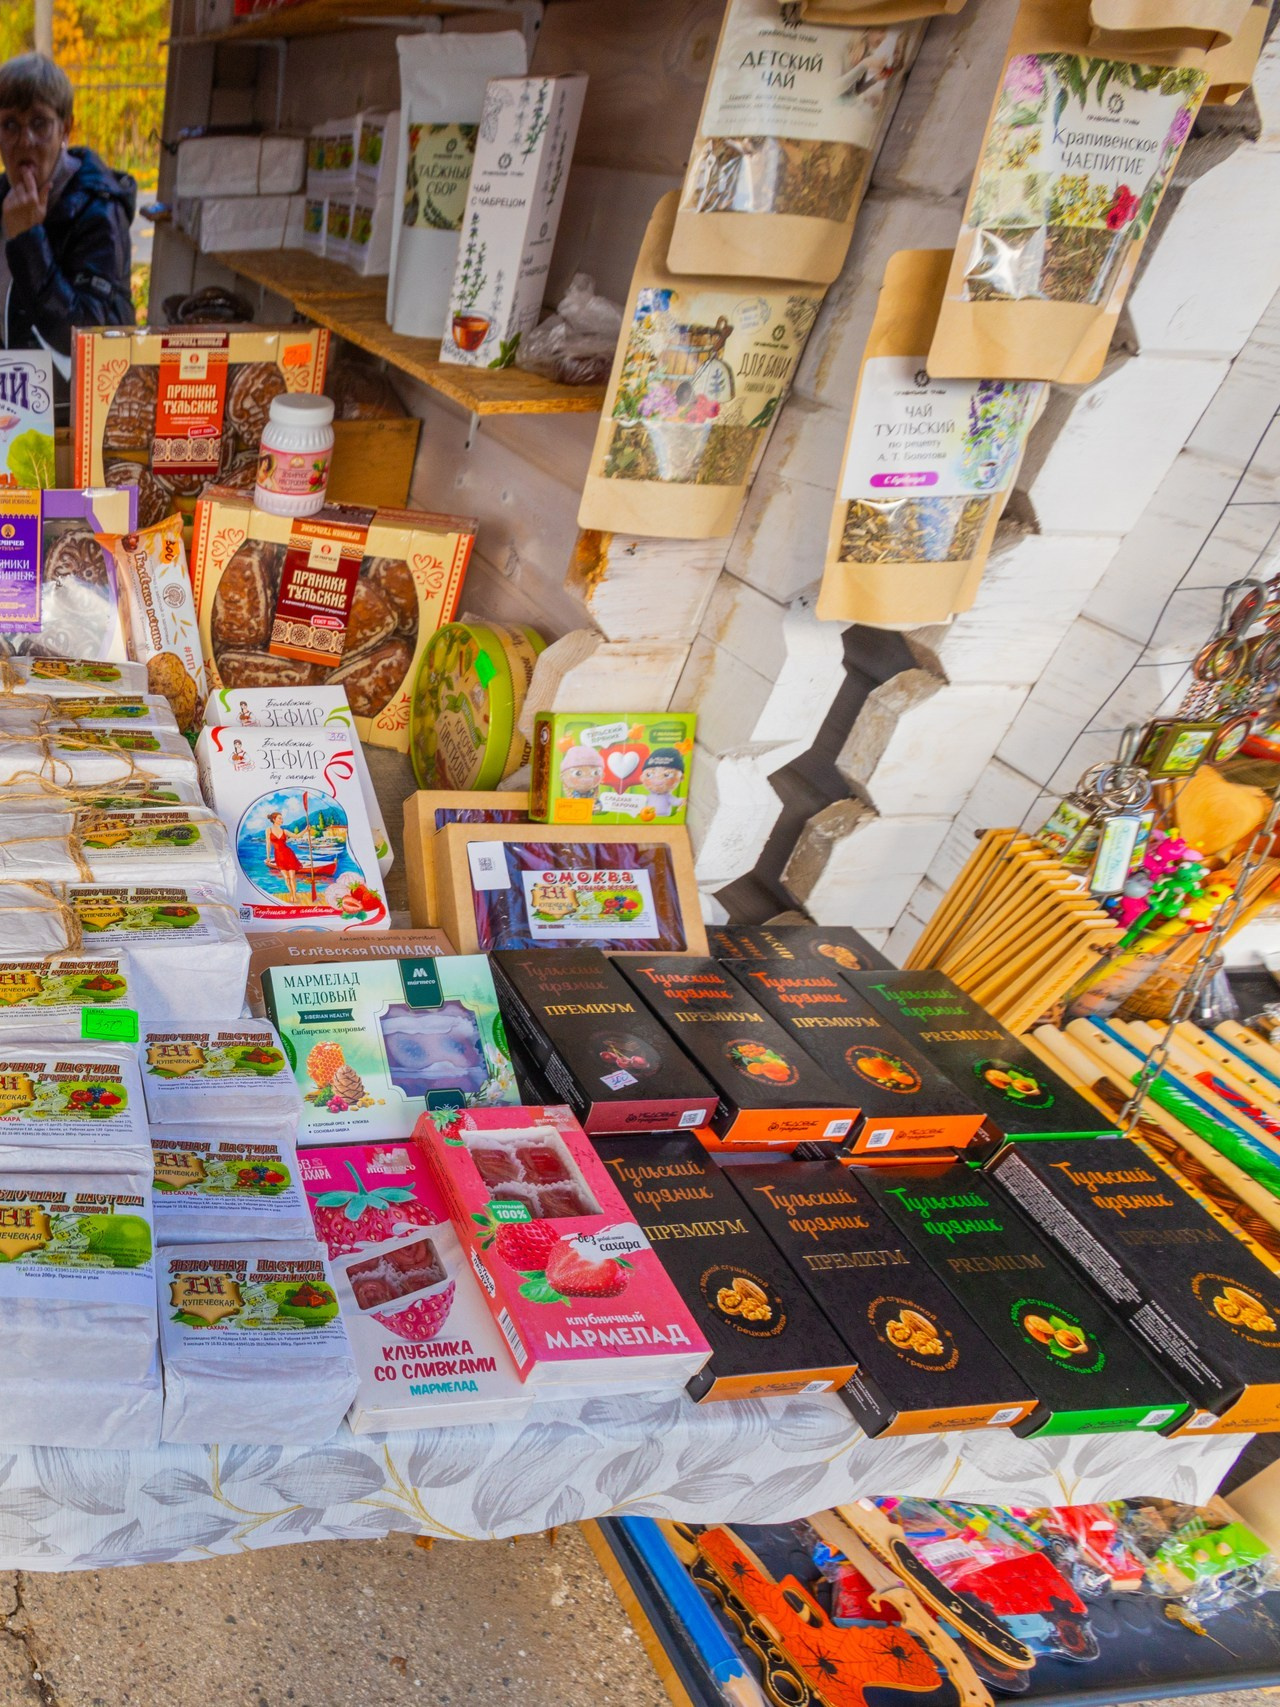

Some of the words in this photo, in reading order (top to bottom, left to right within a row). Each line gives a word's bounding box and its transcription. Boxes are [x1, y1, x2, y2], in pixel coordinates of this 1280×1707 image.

[738, 49, 824, 72] ДЕТСКИЙ
[761, 70, 795, 89] ЧАЙ
[1052, 127, 1159, 154] Крапивенское
[1060, 153, 1145, 175] ЧАЕПИТИЕ
[426, 181, 458, 195] СБОР
[473, 182, 491, 193] ЧАЙ
[479, 197, 526, 208] ЧАБРЕЦОМ
[737, 352, 767, 378] ДЛЯ
[166, 384, 217, 400] ПРЯНИКИ
[162, 399, 219, 414] ТУЛЬСКИЕ
[905, 403, 933, 418] ЧАЙ
[873, 419, 956, 437] ТУЛЬСКИЙ
[292, 569, 347, 593] ПРЯНИКИ
[287, 584, 347, 610] ТУЛЬСКИЕ
[261, 707, 324, 727] ЗЕФИР
[257, 750, 326, 770] ЗЕФИР
[270, 771, 282, 784] без
[285, 774, 316, 783] сахара
[135, 888, 187, 896] ПАСТИЛА
[287, 946, 368, 957] Белёвская
[369, 945, 445, 956] ПОМАДКА
[51, 968, 119, 976] КЛУБНИКОЙ
[59, 960, 119, 970] ПАСТИЛА
[520, 962, 603, 981] Тульский
[283, 972, 361, 989] МАРМЕЛАД
[407, 978, 436, 987] marmeco
[636, 967, 726, 986] Тульский
[748, 971, 838, 989] Тульский
[291, 986, 357, 1006] МЕДОВЫЙ
[538, 979, 608, 997] пряник
[663, 986, 734, 1005] пряник
[868, 984, 959, 1004] Тульский
[778, 991, 848, 1008] пряник
[543, 1002, 637, 1016] ПРЕМИУМ
[673, 1010, 766, 1024] ПРЕМИУМ
[900, 1004, 969, 1022] пряник
[291, 1027, 331, 1036] Сибирское
[333, 1025, 367, 1035] здоровье
[790, 1016, 881, 1028] ПРЕМИУМ
[145, 1033, 210, 1043] ЯБЛОЧНАЯ
[218, 1032, 273, 1040] ПАСТИЛА
[919, 1030, 1006, 1043] PREMIUM
[54, 1062, 120, 1074] ПАСТИЛА
[37, 1073, 78, 1083] ЯГОДНОЕ
[219, 1142, 278, 1154] ПАСТИЛА
[604, 1157, 706, 1189] Тульский
[1048, 1160, 1158, 1193] Тульский
[75, 1193, 144, 1207] ПАСТИЛА
[633, 1186, 715, 1212] пряник
[753, 1184, 858, 1216] Тульский
[885, 1187, 989, 1217] Тульский
[1091, 1193, 1175, 1218] пряник
[496, 1208, 528, 1221] 100%
[642, 1218, 750, 1241] ПРЕМИУМ
[788, 1214, 870, 1241] пряник
[923, 1218, 1004, 1244] пряник
[577, 1232, 597, 1246] без
[1114, 1228, 1224, 1245] ПРЕМИУМ
[599, 1239, 642, 1253] сахара
[168, 1259, 248, 1273] ЯБЛОЧНАЯ
[256, 1259, 324, 1273] ПАСТИЛА
[802, 1249, 911, 1270] ПРЕМИУМ
[946, 1254, 1047, 1274] PREMIUM
[249, 1273, 326, 1282] КЛУБНИКОЙ
[475, 1253, 495, 1292] ПОСТНЫЙ
[182, 1299, 235, 1307] КУПЕЧЕСКАЯ
[565, 1311, 645, 1328] клубничный
[544, 1323, 692, 1353] МАРМЕЛАД
[382, 1340, 474, 1362] КЛУБНИКА
[374, 1363, 398, 1383] СО
[402, 1357, 497, 1380] СЛИВКАМИ
[409, 1379, 479, 1396] МАРМЕЛАД
